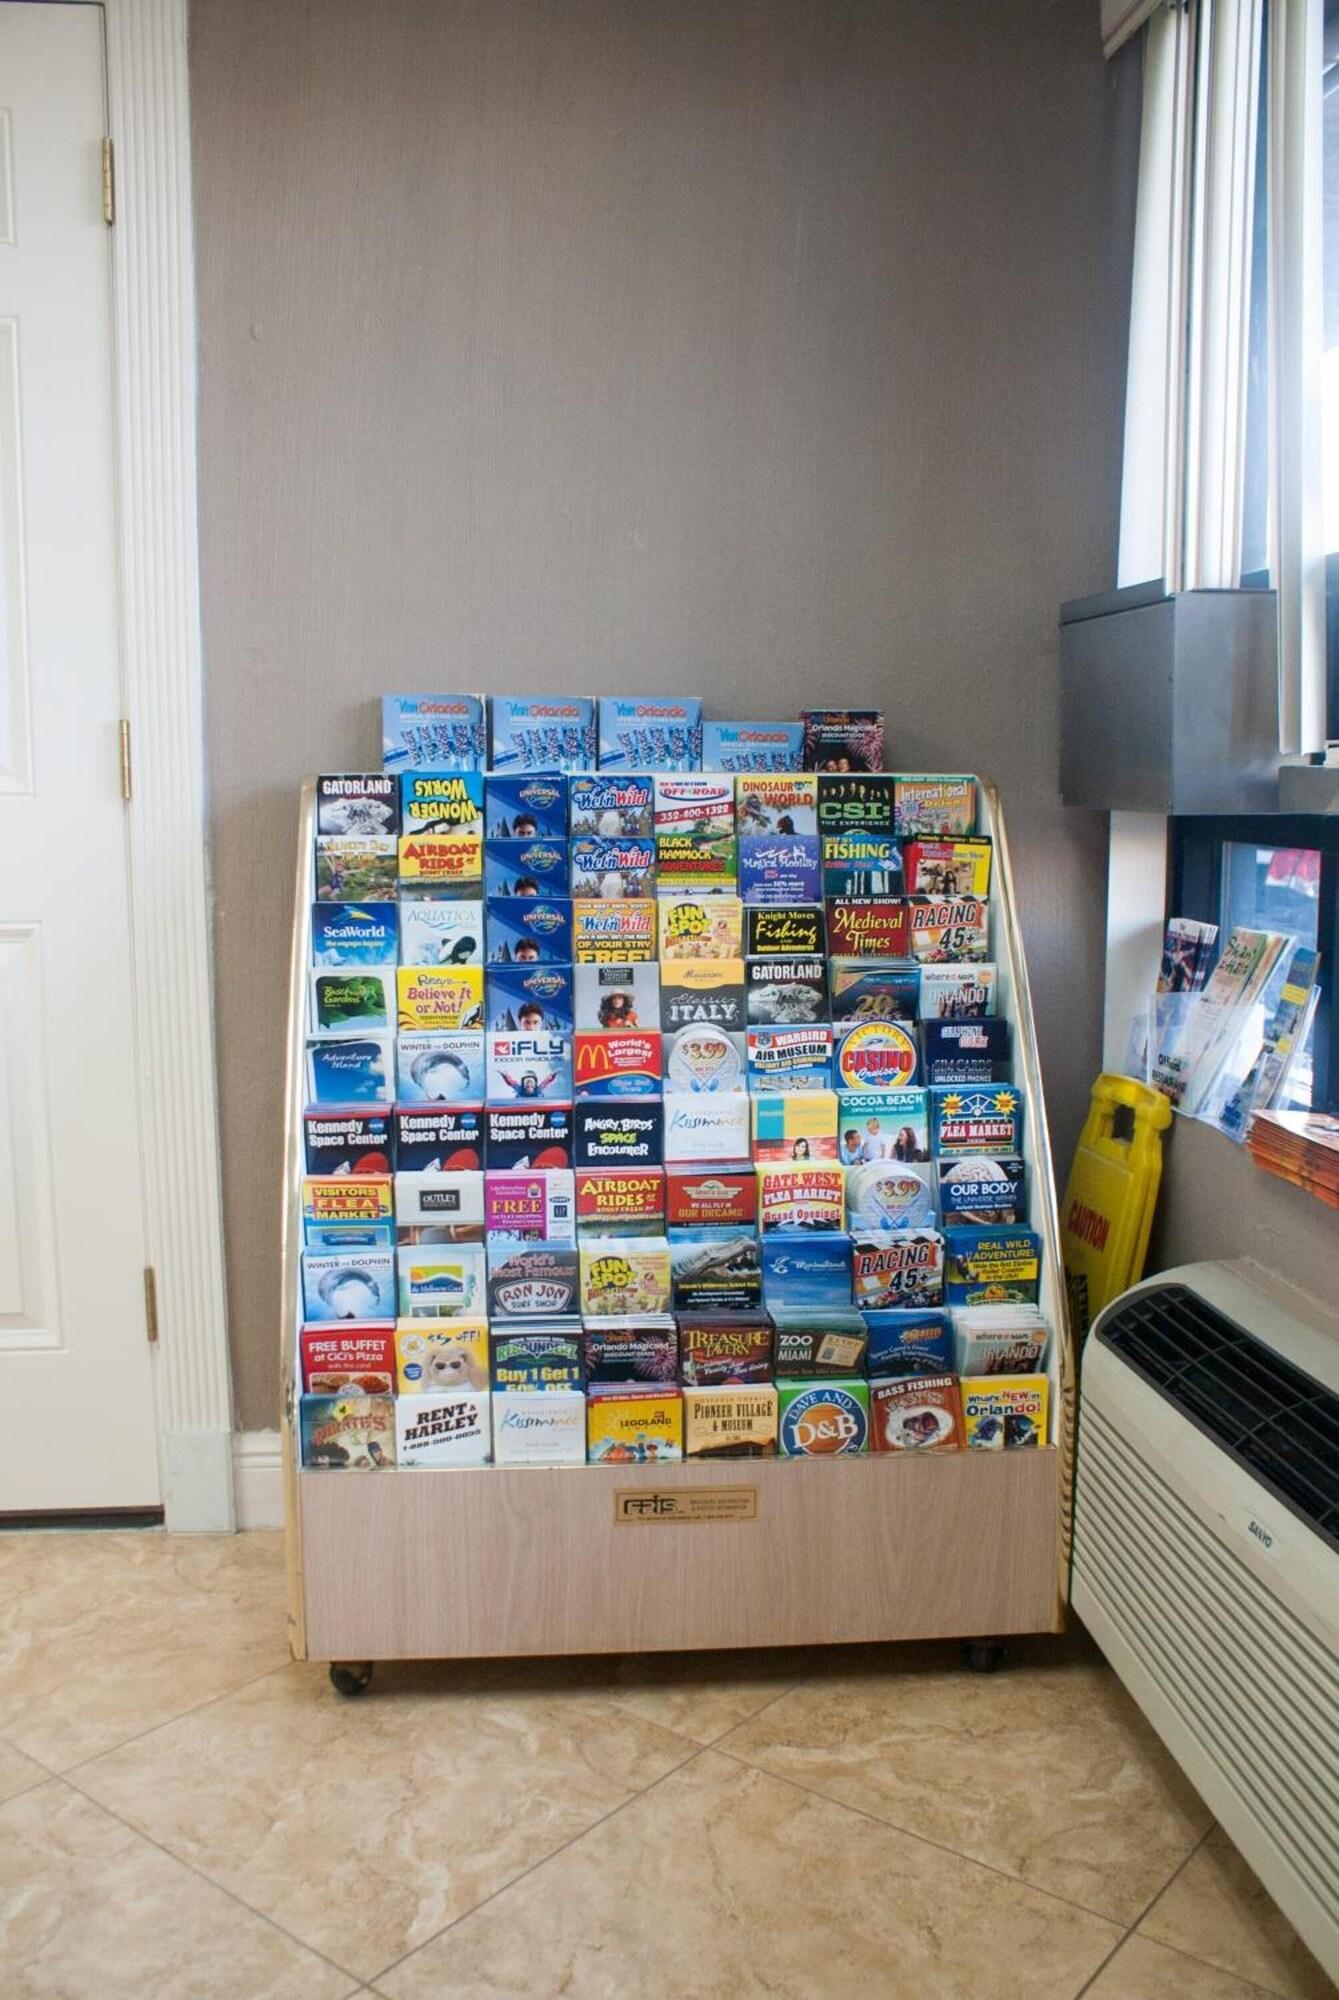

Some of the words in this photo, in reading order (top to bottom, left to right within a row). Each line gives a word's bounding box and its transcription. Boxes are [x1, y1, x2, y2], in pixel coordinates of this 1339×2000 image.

[419, 702, 468, 714] Orlando
[529, 704, 579, 717] Orlando
[637, 705, 687, 717] Orlando
[739, 730, 789, 743] Orlando
[323, 780, 392, 795] GATORLAND
[414, 778, 468, 800] WORKS
[742, 781, 794, 793] DINOSAUR
[763, 793, 815, 807] WORLD
[410, 800, 480, 824] WONDER
[819, 802, 891, 820] CSI:
[659, 837, 693, 849] BLACK
[403, 842, 481, 860] AIRBOAT
[659, 849, 713, 861] HAMMOCK
[825, 843, 890, 859] FISHING
[419, 858, 465, 870] RIDES
[834, 898, 850, 906] ALL
[852, 898, 871, 906] NEW
[872, 898, 901, 906] SHOW!
[408, 909, 476, 922] AQUATICA
[757, 912, 787, 922] Knight
[788, 912, 815, 920] Moves
[833, 907, 903, 934] Medieval
[913, 904, 977, 928] RACING
[323, 926, 386, 938] SeaWorld
[756, 920, 817, 945] Fishing
[845, 930, 891, 951] Times
[752, 965, 824, 980] GATORLAND
[407, 988, 456, 1001] Believe
[458, 988, 473, 1001] It
[415, 1003, 431, 1014] or
[433, 1000, 463, 1014] Not!
[669, 1004, 737, 1021] ITALY
[401, 1042, 436, 1051] WINTER
[443, 1042, 481, 1050] DOLPHIN
[511, 1040, 564, 1056] iFLY
[607, 1038, 652, 1049] World's
[755, 1049, 775, 1061] AIR
[777, 1044, 827, 1060] MUSEUM
[841, 1050, 914, 1073] CASINO
[841, 1096, 886, 1107] COCOA
[886, 1094, 924, 1106] BEACH
[308, 1118, 364, 1136] Kennedy
[400, 1113, 456, 1131] Kennedy
[490, 1112, 547, 1129] Kennedy
[400, 1130, 437, 1145] Space
[439, 1127, 480, 1142] Center
[490, 1128, 526, 1143] Space
[528, 1125, 570, 1141] Center
[969, 1121, 1014, 1138] MARKET
[309, 1134, 345, 1148] Space
[347, 1130, 388, 1147] Center
[580, 1179, 661, 1196] AIRBOAT
[763, 1173, 799, 1189] GATE
[801, 1171, 841, 1187] WEST
[314, 1187, 379, 1198] VISITORS
[950, 1184, 979, 1197] OUR
[981, 1182, 1018, 1195] BODY
[317, 1198, 376, 1209] FLEA
[491, 1199, 543, 1214] FREE
[596, 1193, 645, 1207] RIDES
[314, 1208, 380, 1220] MARKET
[678, 1208, 699, 1218] OUR
[1067, 1199, 1111, 1254] CAUTION
[977, 1241, 1003, 1251] REAL
[1005, 1239, 1031, 1249] WILD
[306, 1260, 340, 1270] WINTER
[351, 1257, 391, 1267] DOLPHIN
[859, 1244, 929, 1275] RACING
[503, 1284, 533, 1302] RON
[536, 1284, 566, 1300] JON
[308, 1341, 338, 1353] FREE
[340, 1339, 387, 1352] BUFFET
[592, 1342, 628, 1351] Orlando
[684, 1329, 769, 1351] TREASURE
[779, 1335, 814, 1347] ZOO
[314, 1353, 326, 1362] at
[356, 1350, 384, 1361] Pizza
[704, 1343, 751, 1358] TAVERN
[778, 1349, 813, 1361] MIAMI
[496, 1367, 527, 1383] Buy
[540, 1366, 569, 1381] Get
[877, 1384, 905, 1400] BASS
[907, 1377, 953, 1392] FISHING
[1001, 1390, 1030, 1402] NEW
[693, 1403, 732, 1419] PIONEER
[736, 1400, 774, 1418] VILLAGE
[788, 1392, 819, 1421] DAVE
[822, 1391, 853, 1409] AND
[966, 1400, 1041, 1416] Orlando!
[417, 1403, 468, 1426] RENT
[404, 1413, 480, 1441] HARLEY
[619, 1417, 673, 1428] LEGOLAND
[721, 1419, 754, 1432] MUSEUM
[1248, 1520, 1273, 1548] SANYO
